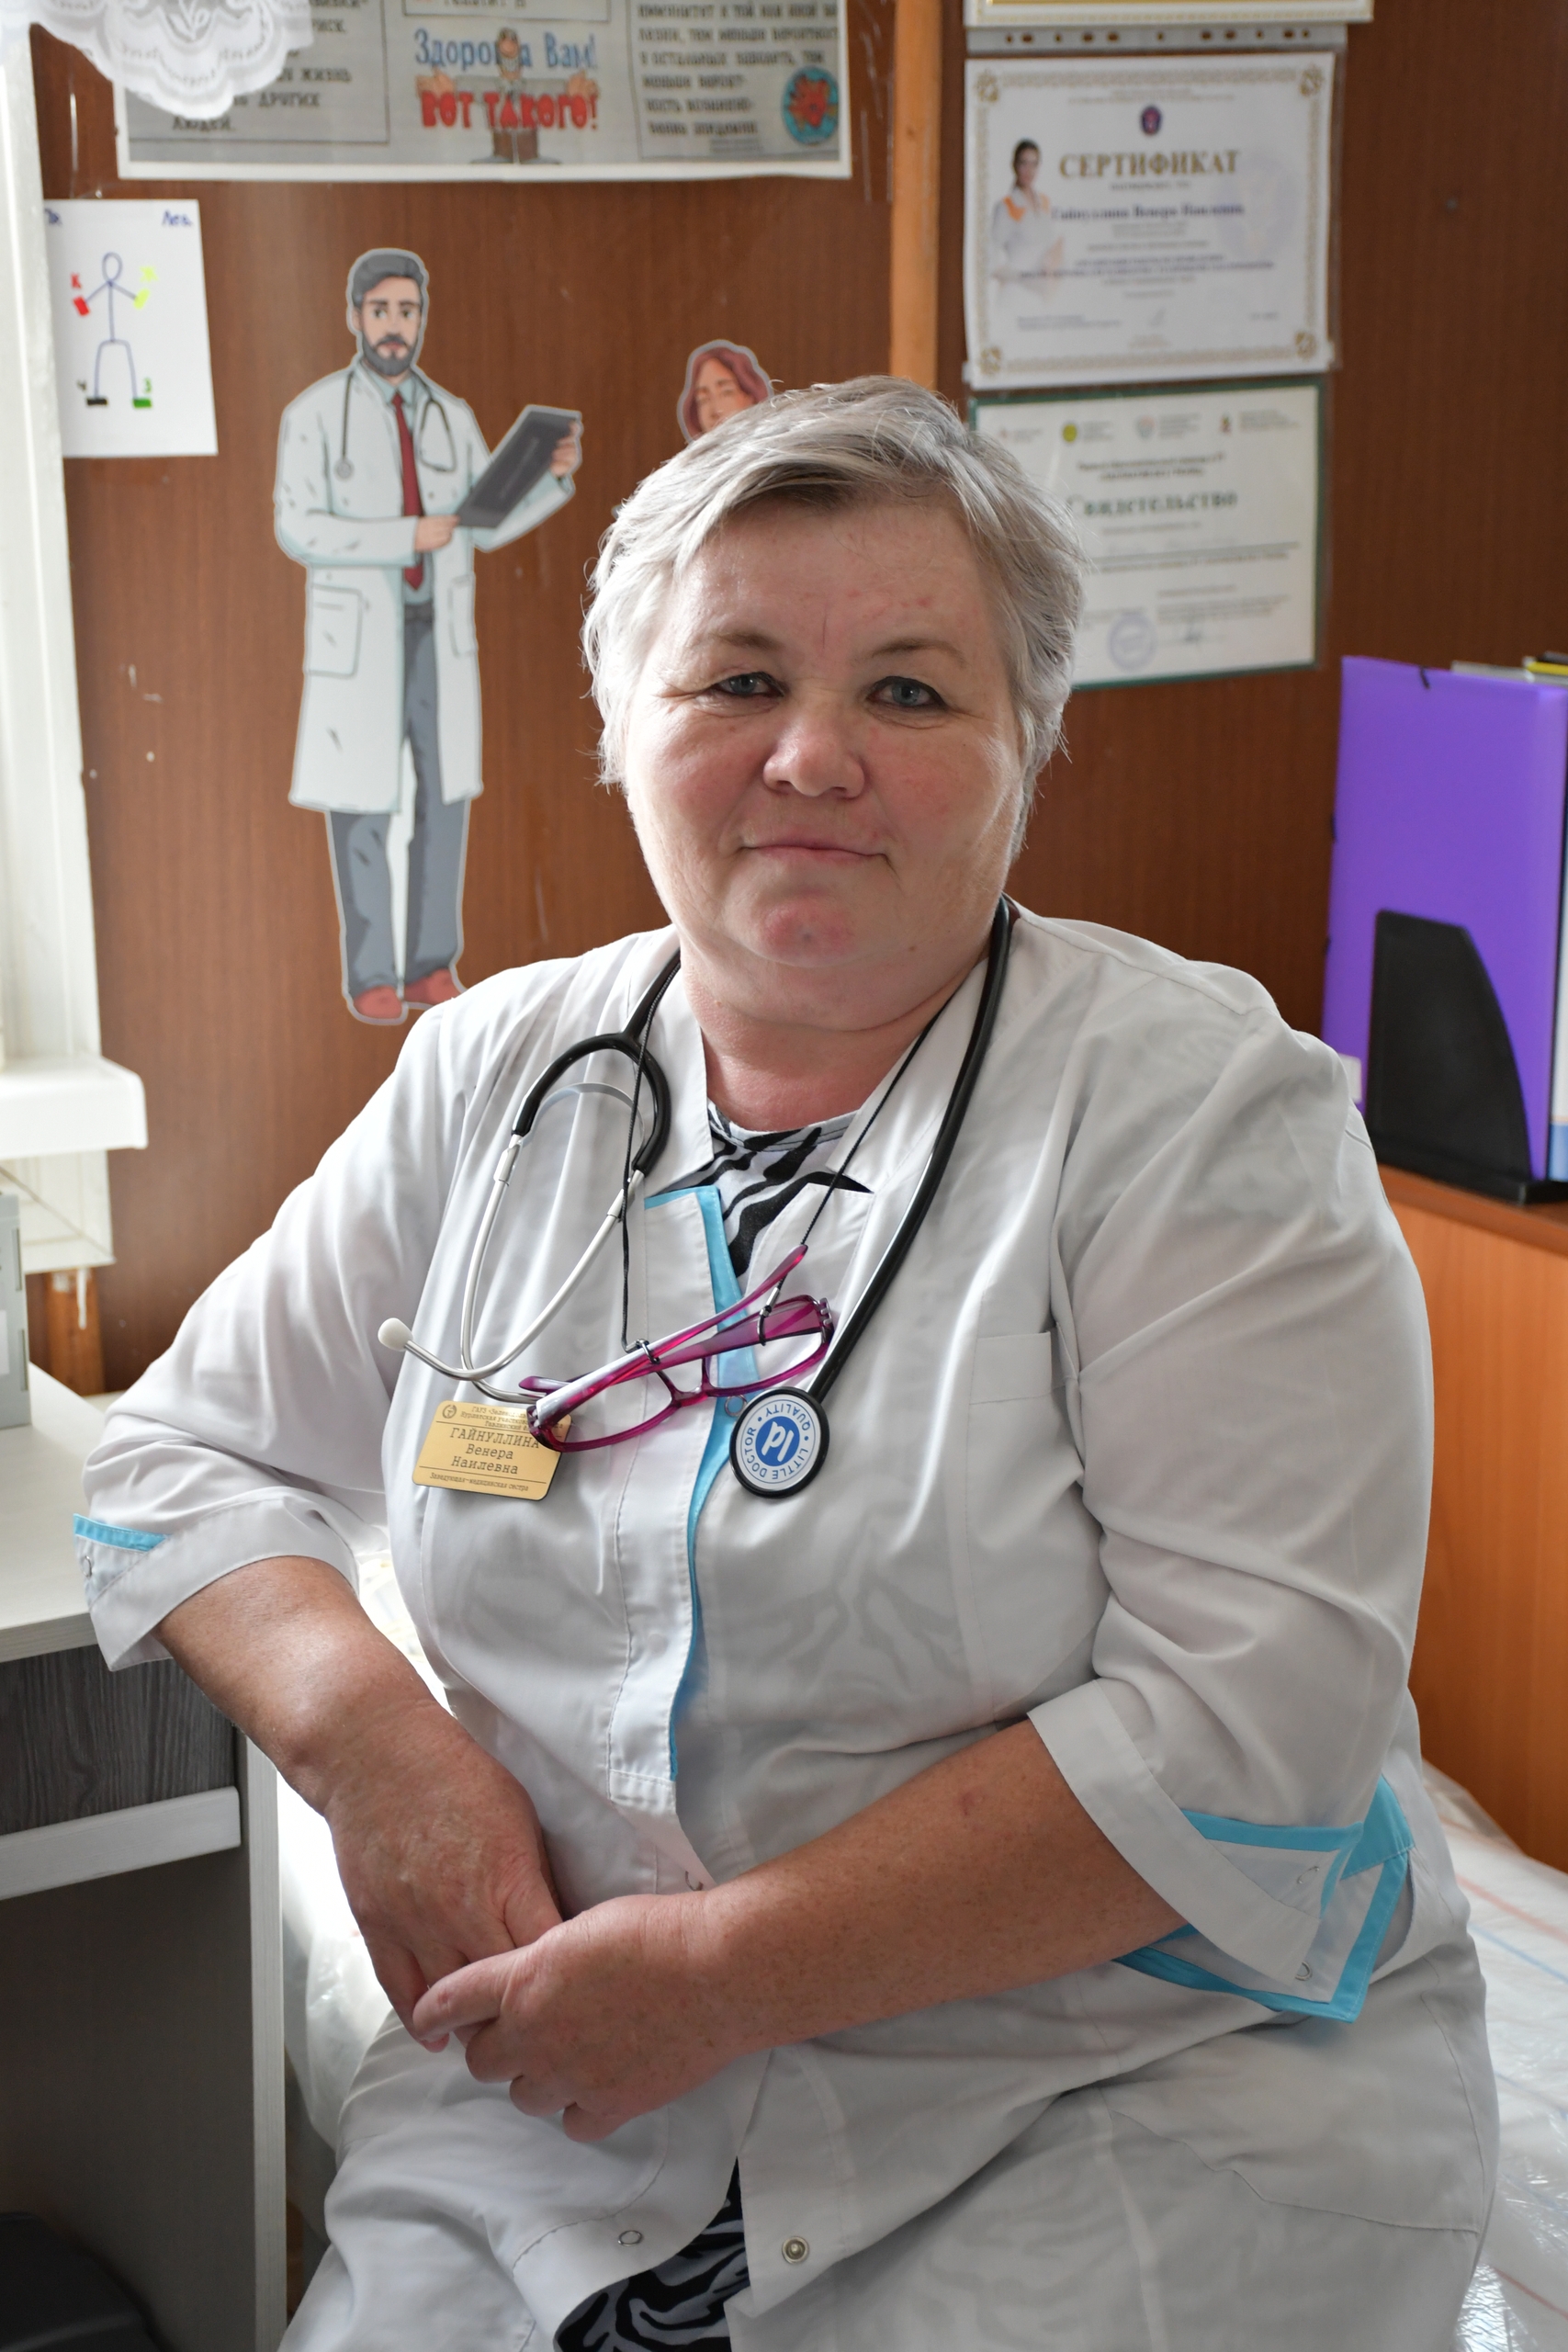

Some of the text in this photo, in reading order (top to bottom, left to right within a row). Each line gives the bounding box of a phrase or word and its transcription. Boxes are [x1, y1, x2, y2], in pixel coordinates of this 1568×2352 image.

[544, 31, 597, 69] Вам!
[421, 90, 599, 130] ВОТ ТАКОГО!
[1059, 150, 1239, 179] СЕРТИФИКАТ
[765, 1403, 811, 1430] QUALITY
[449, 1427, 540, 1449] ГАЙНУЛЛИНА
[466, 1443, 514, 1460] Венера
[451, 1456, 519, 1475] Наилевна
[744, 1427, 809, 1480] LITTLE DOCTOR
